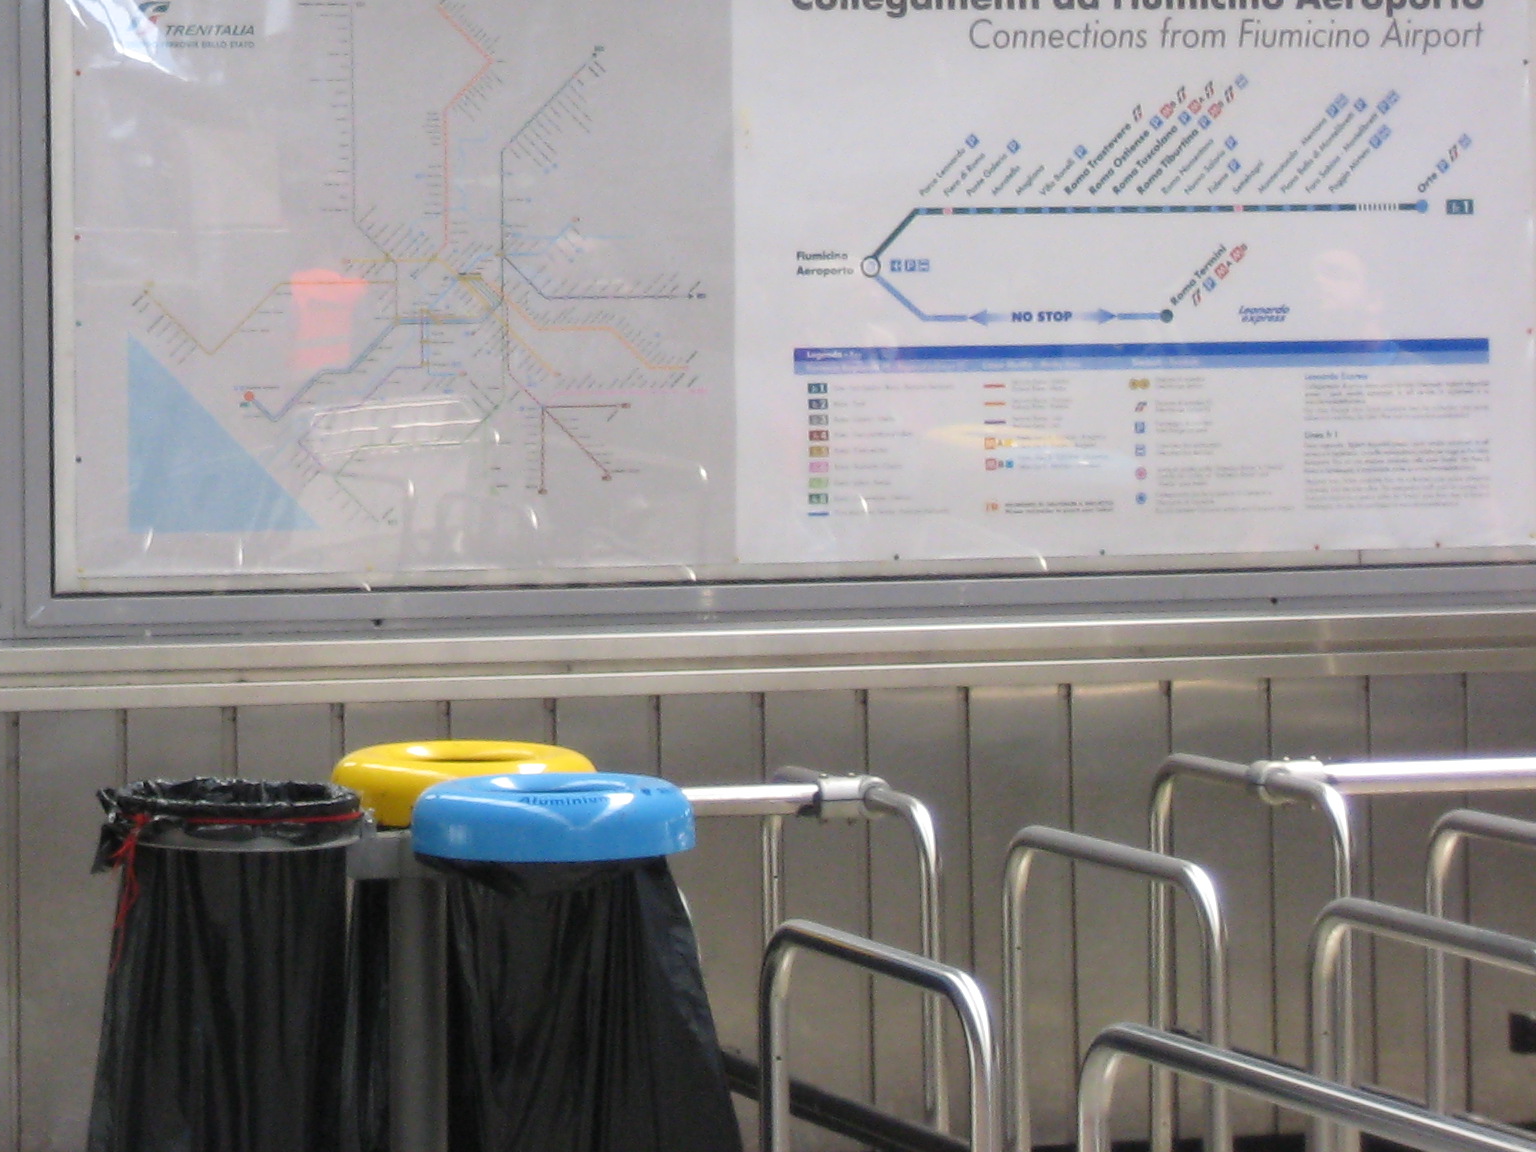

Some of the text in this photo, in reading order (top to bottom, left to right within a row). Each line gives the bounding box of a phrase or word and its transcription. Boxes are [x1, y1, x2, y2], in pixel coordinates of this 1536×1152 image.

[165, 25, 254, 36] TRENITALIA
[969, 18, 1483, 54] Connections from Fiumicino Airport
[1064, 123, 1131, 195] Roma Trastevere
[1088, 130, 1150, 195] Roma Ostiense
[1136, 129, 1199, 195] Roma Tiburtina
[1113, 168, 1139, 195] Roma
[1417, 172, 1437, 193] Orte
[797, 251, 848, 261] Fiumicino
[797, 266, 854, 277] Aeroporto
[1170, 244, 1227, 306] Roma Termini
[1012, 312, 1072, 322] NO STOP
[1239, 305, 1290, 315] Leonardo
[520, 794, 610, 806] Aluminiu
